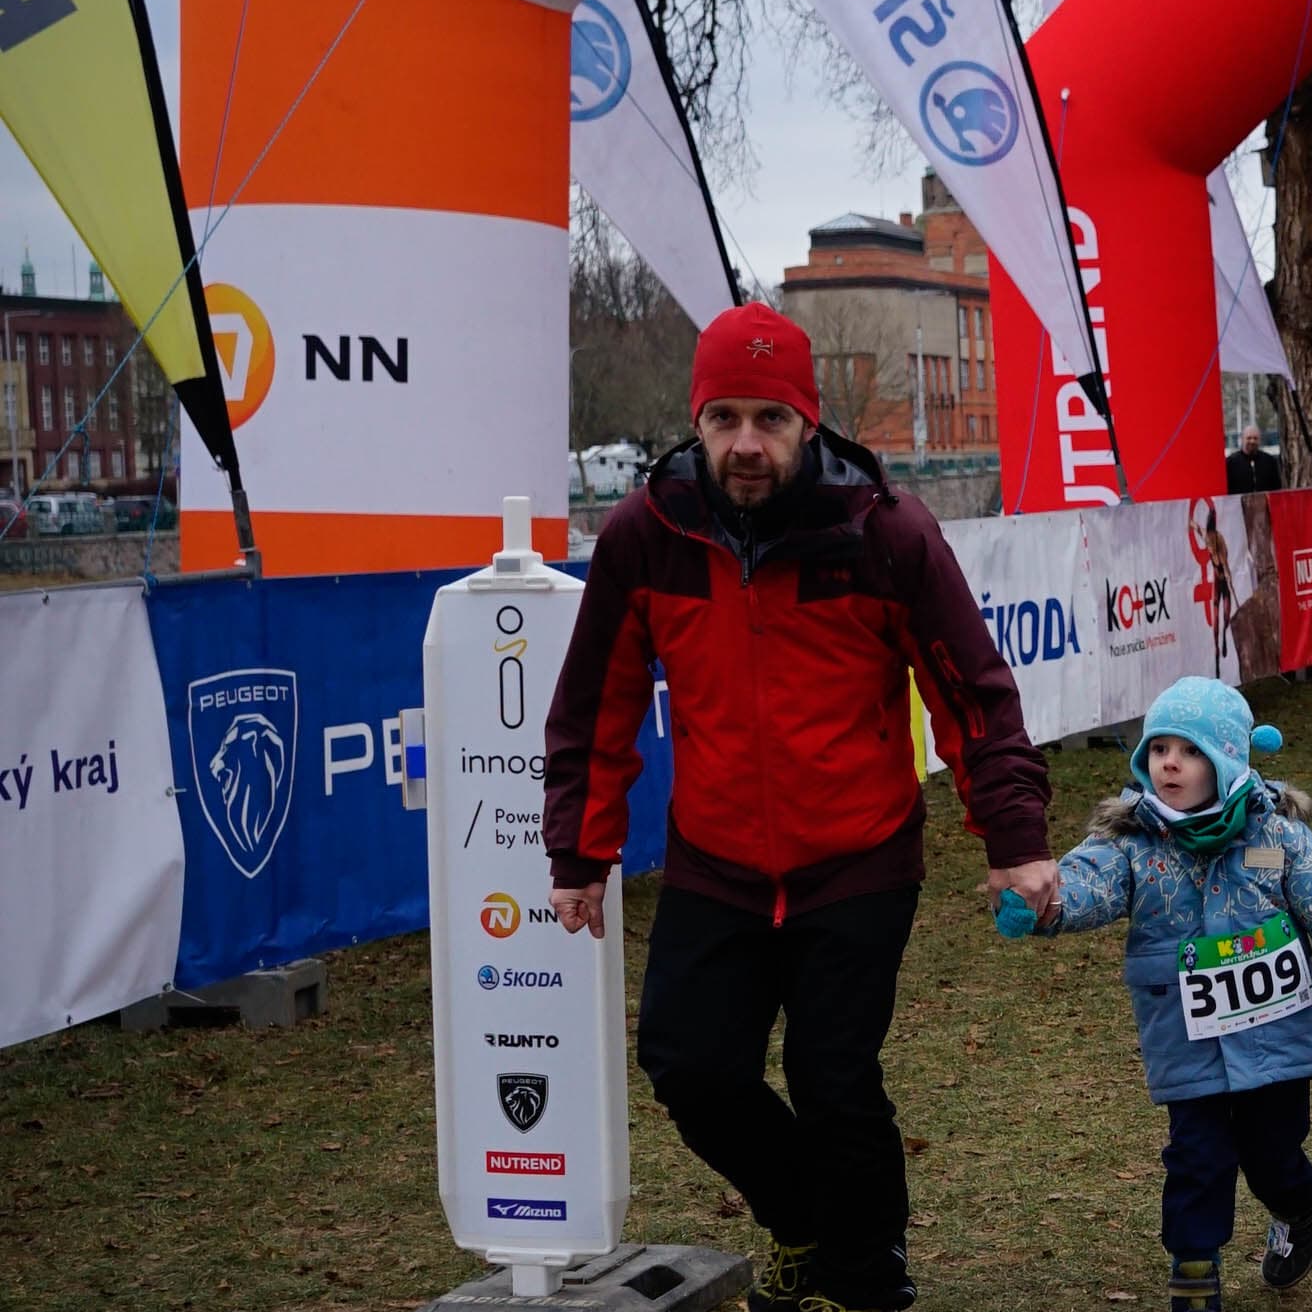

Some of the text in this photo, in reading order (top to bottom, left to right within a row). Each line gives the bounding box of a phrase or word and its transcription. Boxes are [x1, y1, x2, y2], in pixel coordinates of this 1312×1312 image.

[302, 332, 410, 384] NN
[1105, 576, 1170, 633] kotex
[199, 684, 289, 713] PEUGEOT
[50, 740, 120, 794] kraj
[460, 747, 546, 780] innog
[494, 807, 545, 825] Powe
[494, 828, 517, 849] by
[502, 968, 563, 988] ŠKODA
[1185, 949, 1301, 1018] 3109
[497, 1034, 559, 1049] RUNTO
[501, 1077, 544, 1087] PEUGEOT
[490, 1155, 562, 1171] NUTREND
